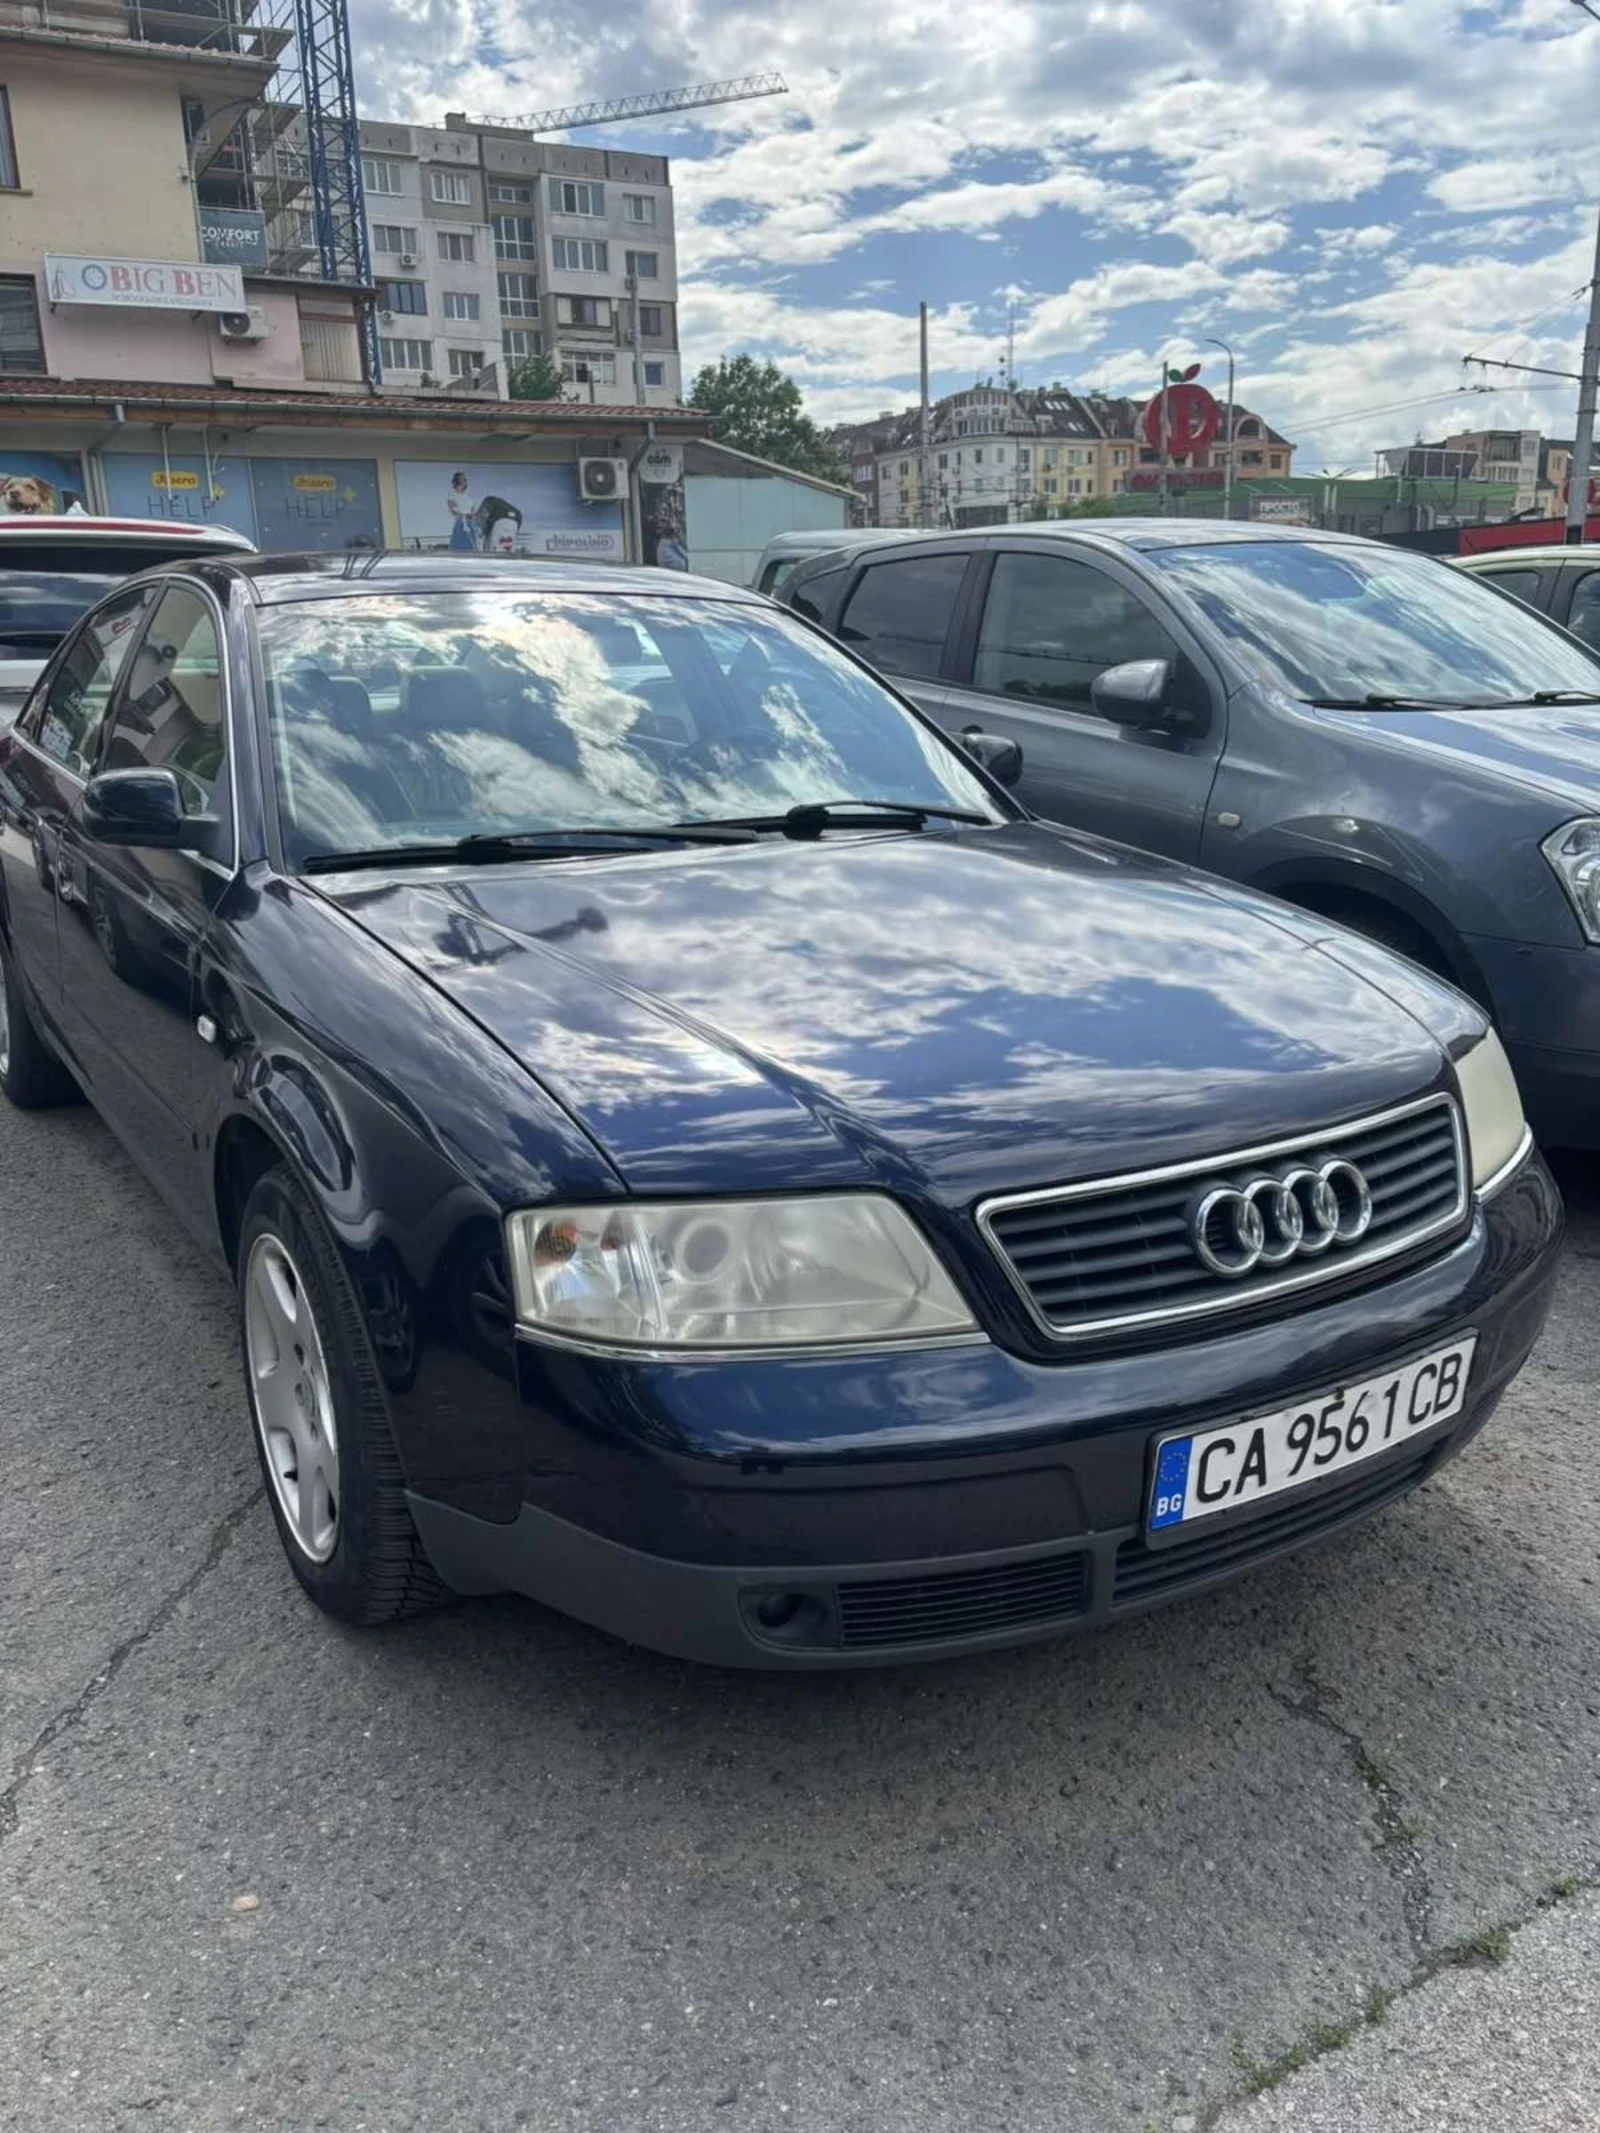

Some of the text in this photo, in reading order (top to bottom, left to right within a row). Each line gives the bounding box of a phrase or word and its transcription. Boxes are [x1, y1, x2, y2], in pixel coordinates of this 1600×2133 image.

[200, 226, 259, 242] COMFORT
[108, 265, 237, 298] BIG BEN
[147, 495, 216, 518] HELP
[284, 497, 347, 518] HELP
[1195, 1352, 1463, 1503] CA 9561 CB
[1155, 1493, 1183, 1517] BG
